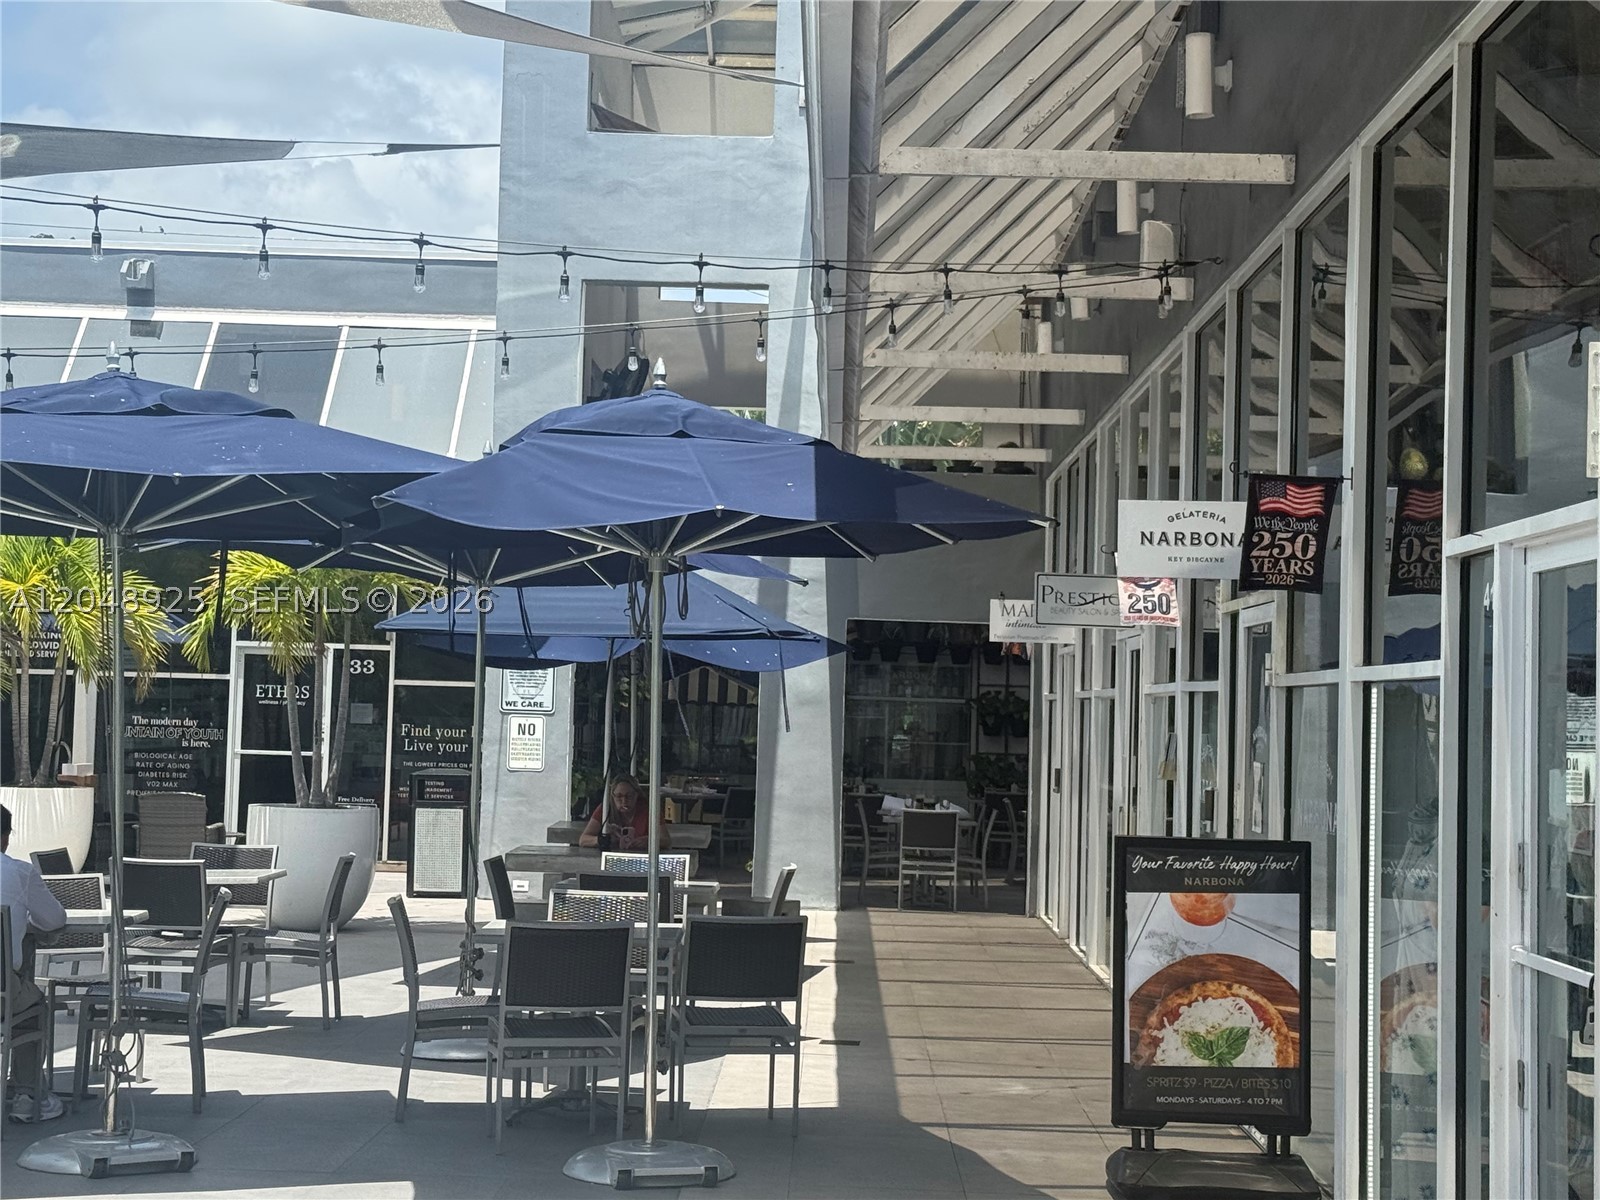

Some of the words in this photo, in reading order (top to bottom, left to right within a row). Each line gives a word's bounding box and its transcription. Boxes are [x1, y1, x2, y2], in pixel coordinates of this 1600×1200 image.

[1167, 510, 1226, 524] GELATERIA
[1250, 531, 1317, 560] 250
[1250, 558, 1314, 576] YEARS
[1265, 574, 1294, 585] 2026
[1041, 585, 1119, 606] PRESTIG
[1127, 592, 1171, 615] 250
[132, 715, 148, 725] The
[150, 717, 181, 726] modern
[183, 717, 198, 728] day
[165, 727, 182, 739] OF
[183, 728, 224, 740] YOUTH
[401, 723, 431, 737] Find
[435, 728, 467, 740] your
[518, 723, 536, 736] NO
[181, 738, 189, 747] is
[190, 739, 211, 748] here.
[404, 738, 433, 752] Live
[437, 742, 469, 755] your
[134, 752, 176, 760] BIOLOGICAL
[351, 796, 376, 804] Delivery
[1131, 855, 1163, 874] Your
[1164, 855, 1216, 870] Favorite
[1219, 855, 1258, 877] Happy
[1259, 855, 1299, 871] Hour!
[1184, 877, 1245, 887] NARBONA
[1146, 1076, 1182, 1088] SPRITZ
[1184, 1076, 1197, 1088] $9
[1203, 1077, 1234, 1089] PIZZA
[1241, 1078, 1271, 1089] BITES
[1273, 1078, 1292, 1090] $10
[1156, 1096, 1194, 1104] MONDAYS
[1198, 1096, 1241, 1105] SATURDAYS
[1247, 1097, 1253, 1105] 4
